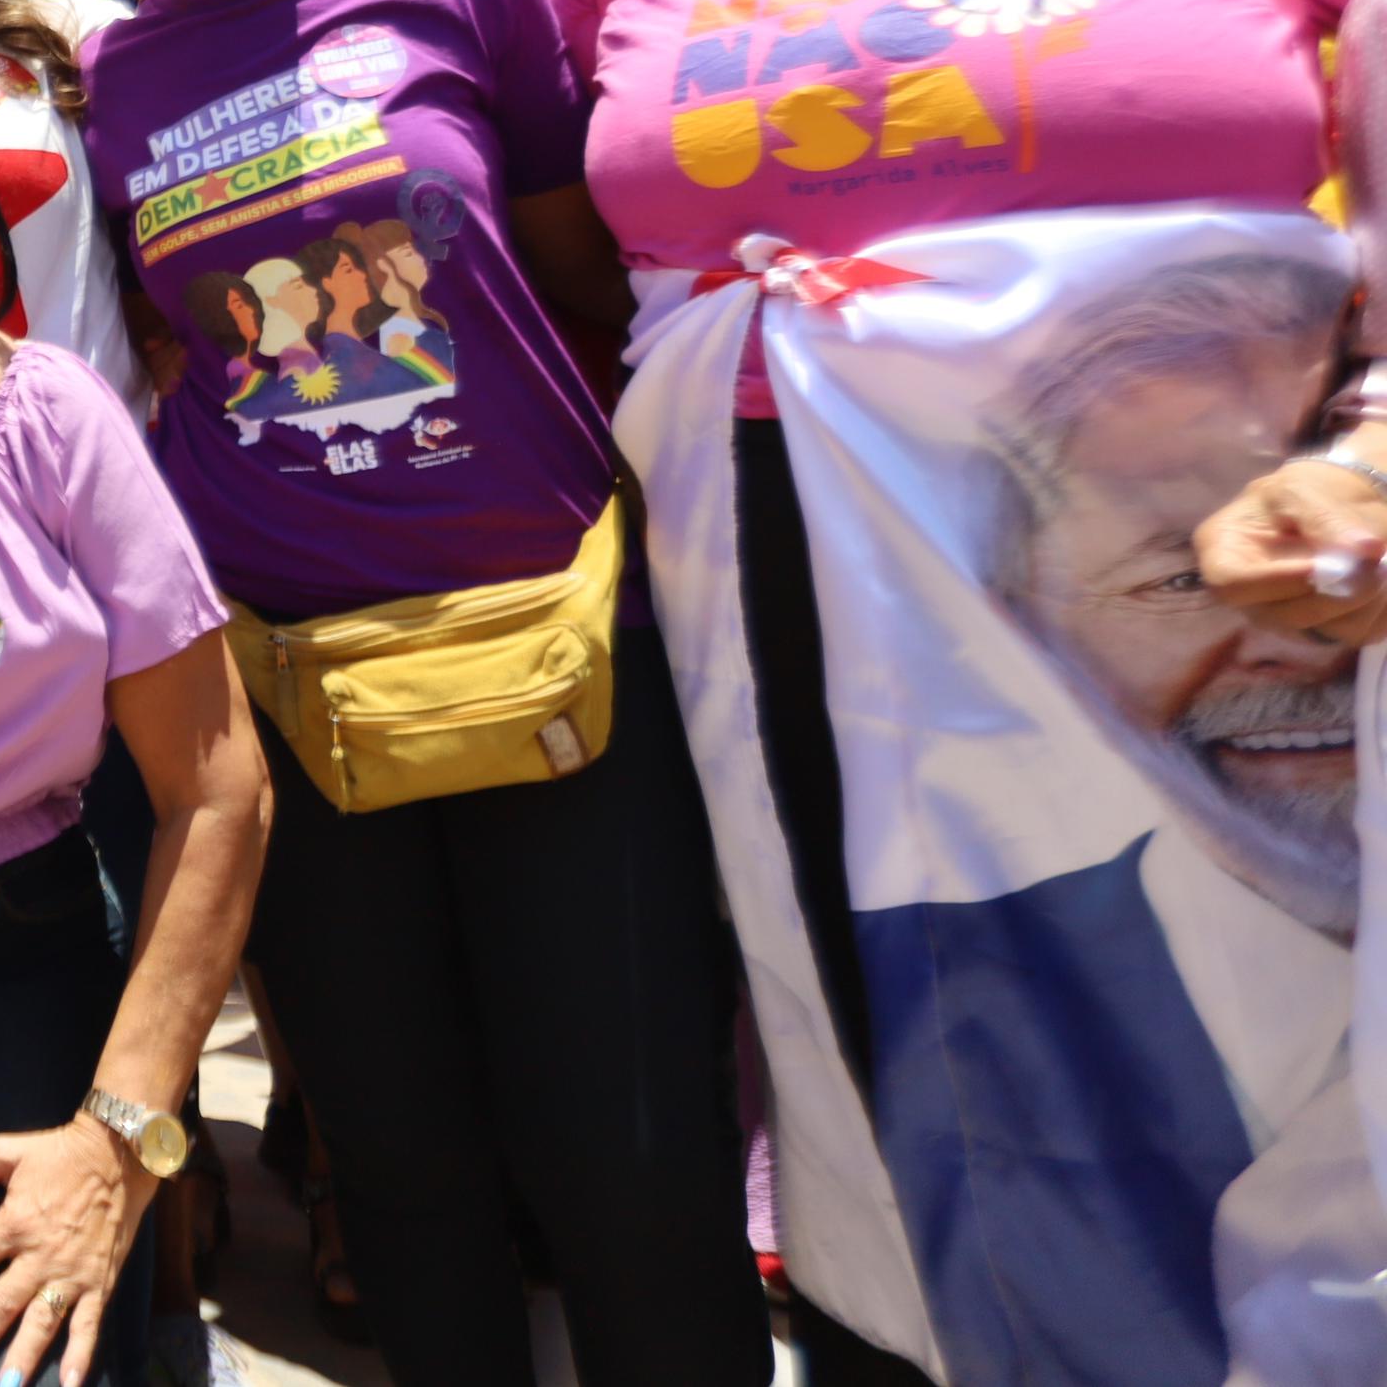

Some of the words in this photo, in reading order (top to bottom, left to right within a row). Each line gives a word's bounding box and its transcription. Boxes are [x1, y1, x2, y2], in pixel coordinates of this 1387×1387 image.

[148, 65, 317, 162] MULHERES
[671, 66, 1006, 190] USA
[129, 164, 168, 201] EM
[177, 114, 304, 179] DEFESA
[230, 202, 281, 226] ANISTIA
[330, 456, 379, 476] ELAS
